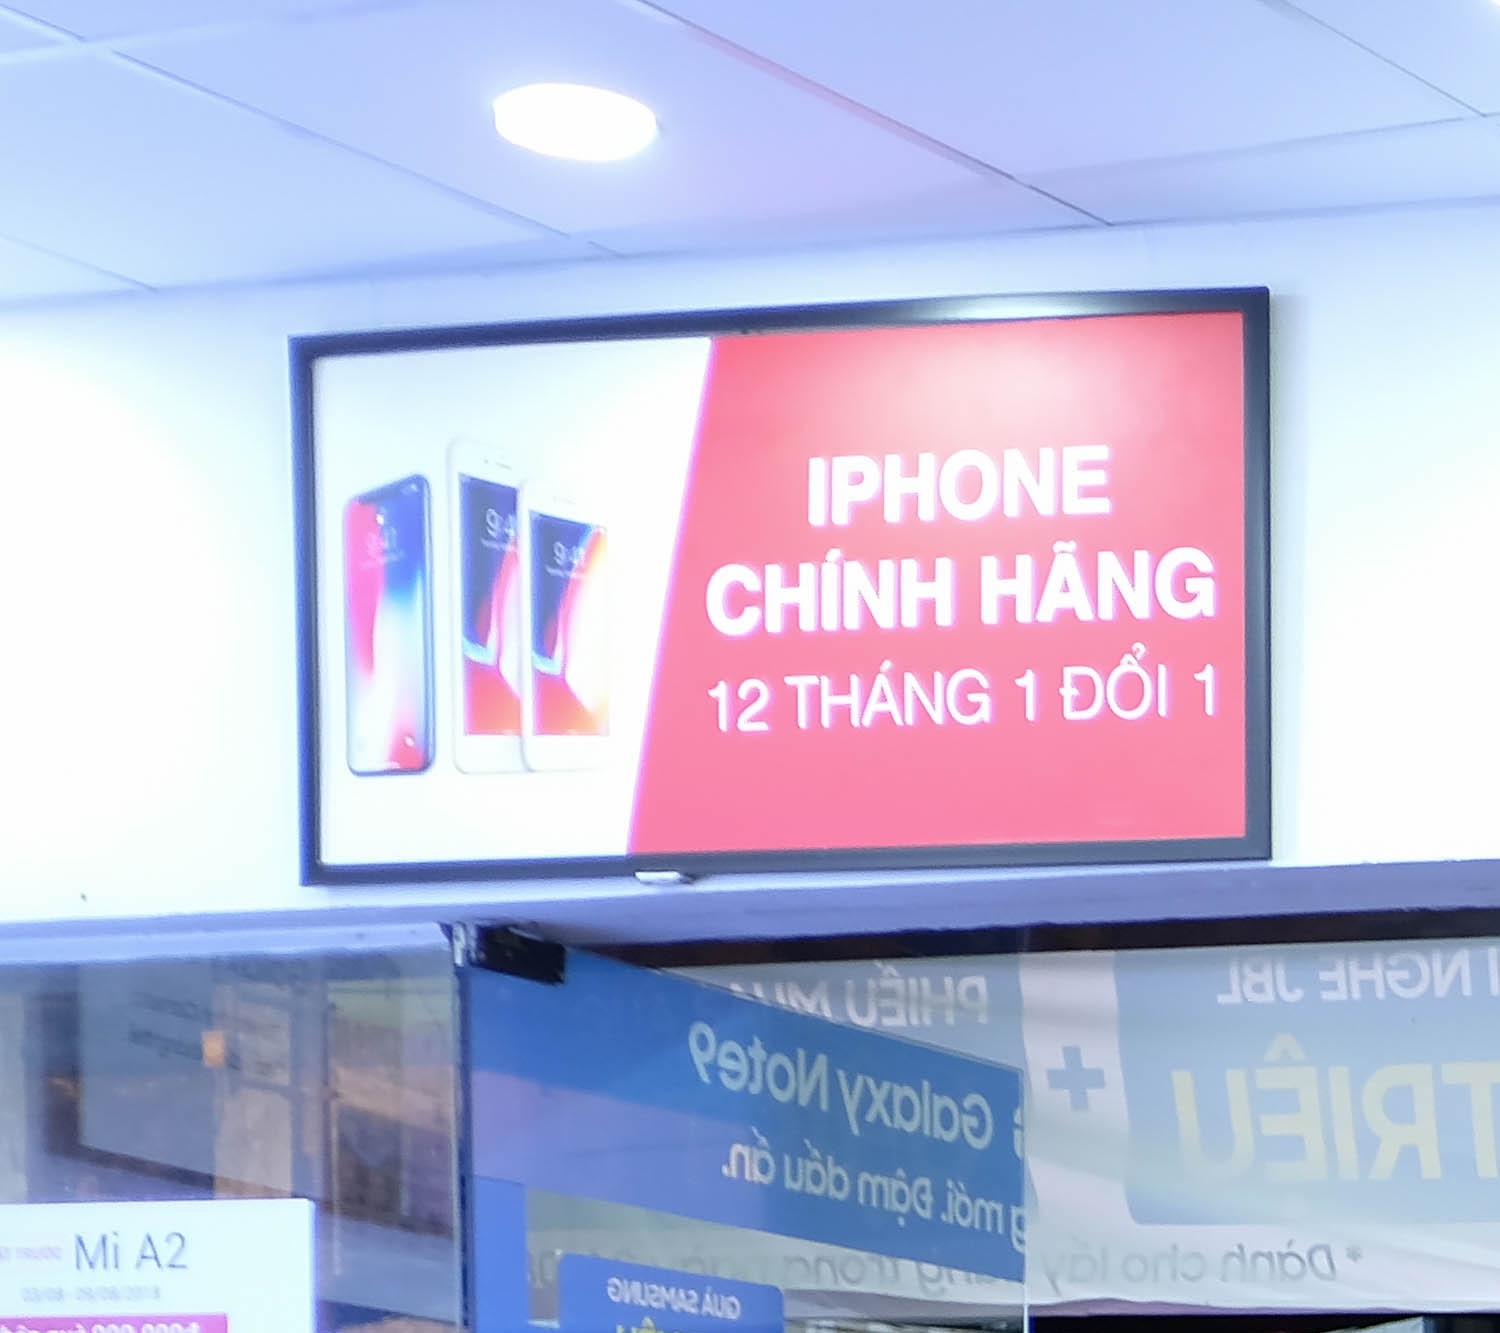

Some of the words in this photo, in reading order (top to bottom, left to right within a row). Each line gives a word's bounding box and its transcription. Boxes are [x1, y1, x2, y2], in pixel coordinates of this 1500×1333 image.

[807, 446, 1109, 525] IPHONE
[705, 547, 951, 636] CHÍNH
[980, 540, 1216, 628] HÃNG
[707, 676, 771, 733] 12
[788, 659, 991, 729] THÁNG
[1014, 671, 1036, 723] 1
[1059, 642, 1170, 721] ĐỔI
[1195, 664, 1216, 716] 1
[73, 1231, 119, 1271] Mi
[135, 1231, 188, 1271] A2
